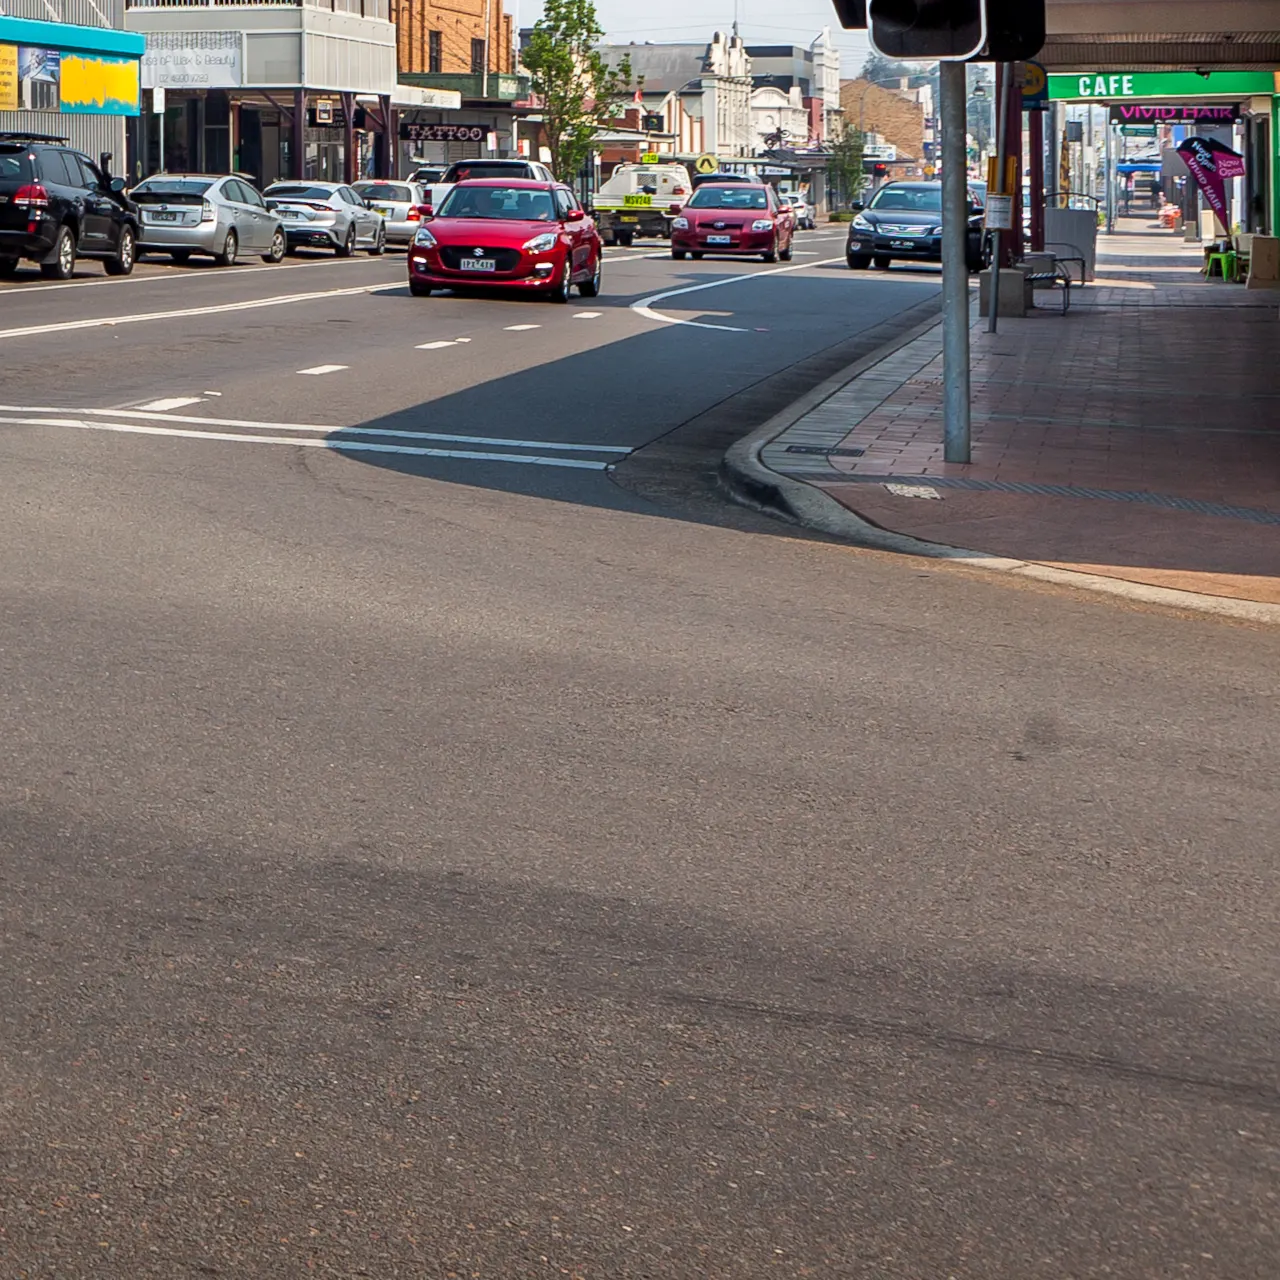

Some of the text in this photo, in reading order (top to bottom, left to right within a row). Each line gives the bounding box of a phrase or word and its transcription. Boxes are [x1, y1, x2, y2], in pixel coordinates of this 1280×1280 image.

[1079, 75, 1134, 96] CAFE
[1120, 106, 1232, 119] VIVID HAIR
[408, 125, 483, 141] TATTOO
[1191, 141, 1212, 158] Now
[1196, 153, 1216, 172] Open
[1188, 158, 1221, 210] VIVID HAIR
